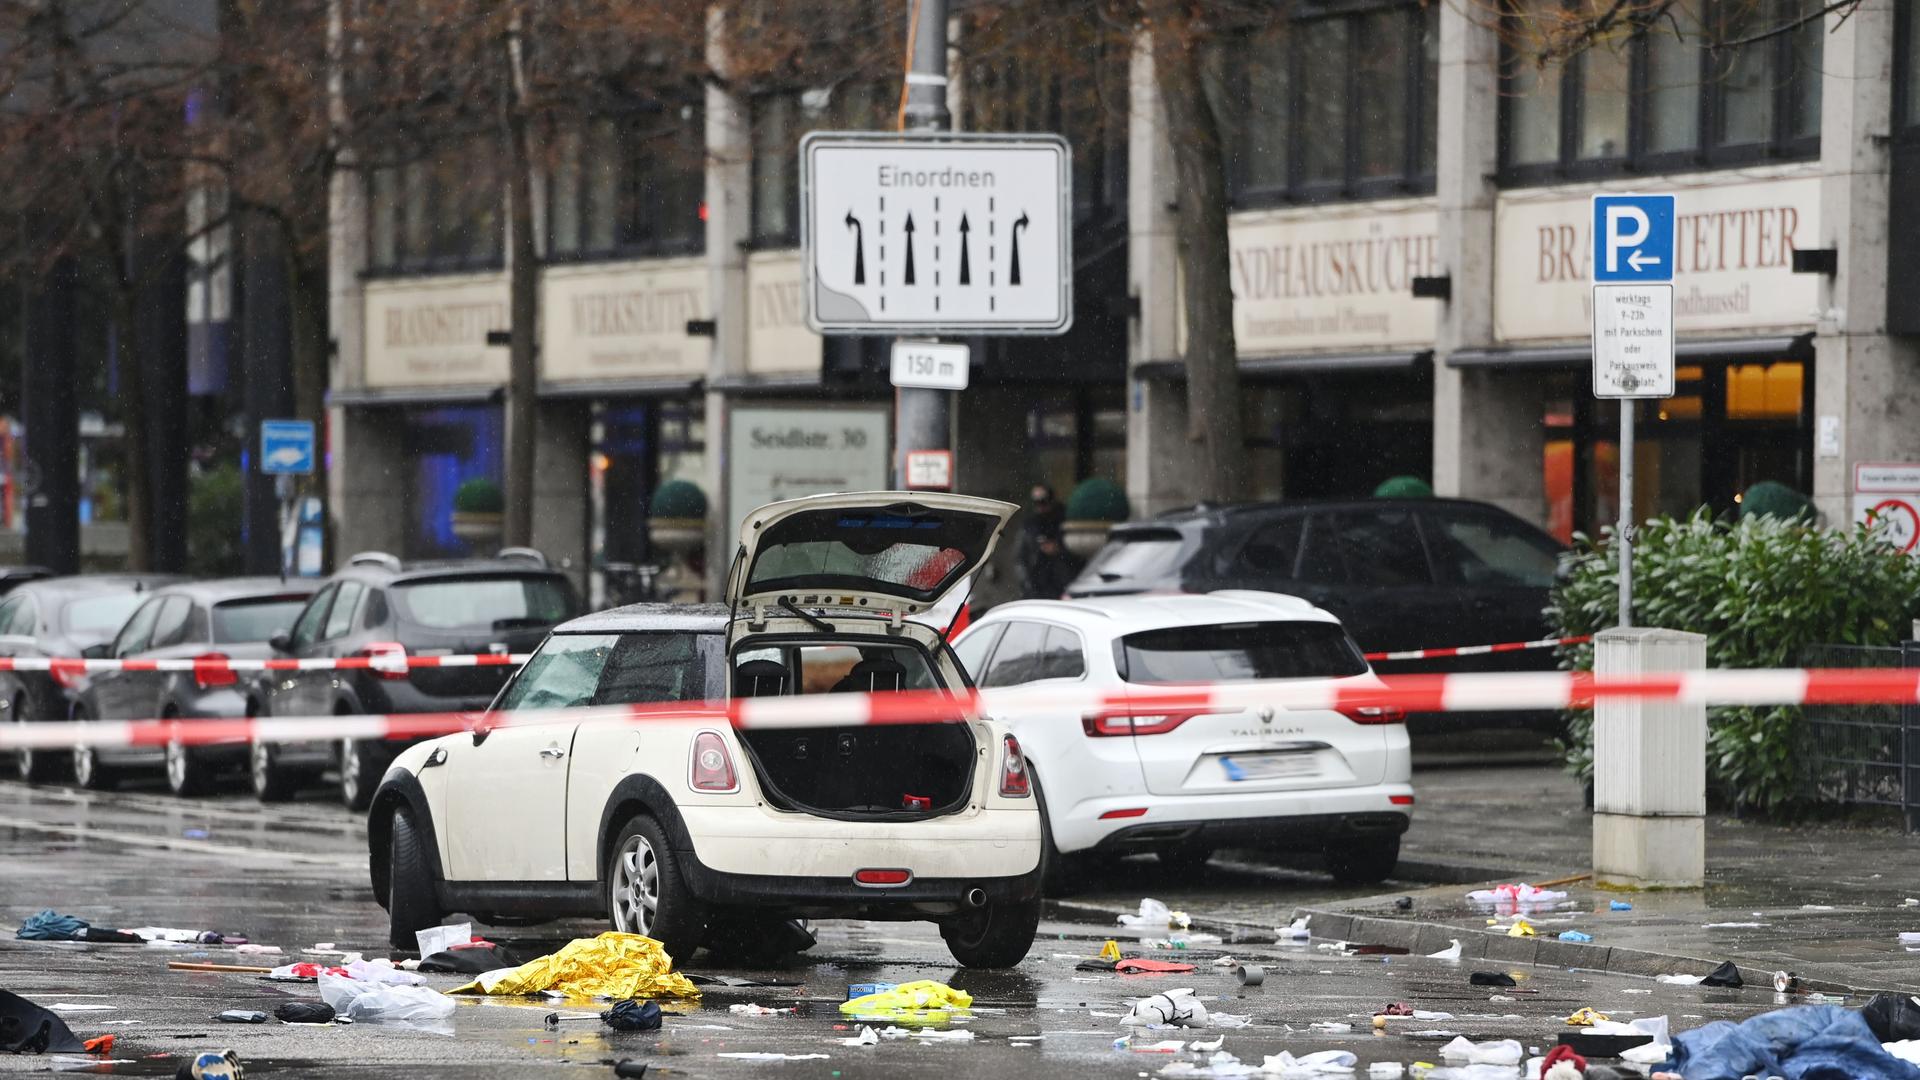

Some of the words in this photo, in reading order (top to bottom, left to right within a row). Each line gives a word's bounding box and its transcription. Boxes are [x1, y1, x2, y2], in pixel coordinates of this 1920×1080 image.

[879, 165, 995, 188] Einordnen
[1537, 207, 1799, 283] BRATETTER
[1606, 206, 1650, 272] P
[1616, 292, 1651, 305] werktags
[1621, 310, 1645, 321] 9-23h
[1604, 327, 1617, 337] mit
[1620, 327, 1663, 337] Parkschein
[1624, 344, 1641, 354] oder
[908, 355, 933, 375] 150
[939, 362, 954, 376] m
[1609, 360, 1657, 371] Parkausweis
[842, 427, 867, 448] 30
[1231, 727, 1304, 737] TALISMAN
